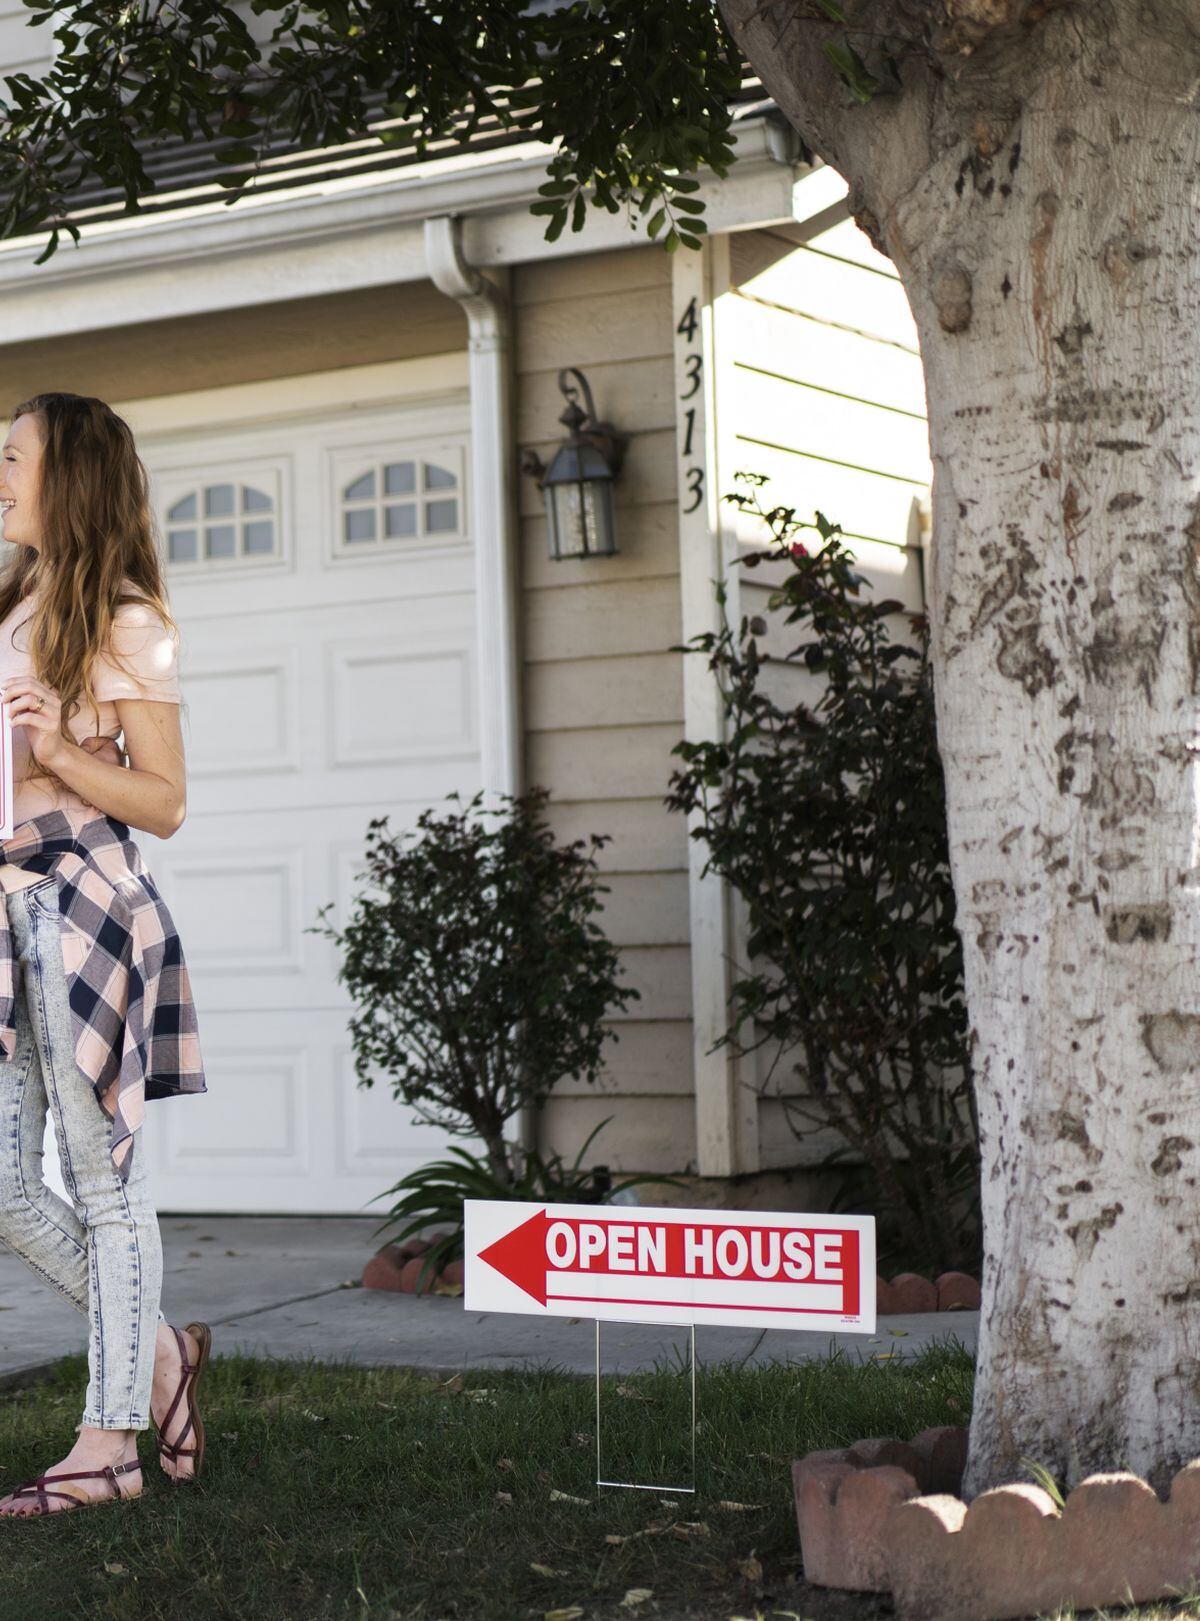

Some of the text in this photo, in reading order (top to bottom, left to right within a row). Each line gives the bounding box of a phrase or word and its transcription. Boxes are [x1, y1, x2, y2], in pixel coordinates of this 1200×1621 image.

[677, 296, 704, 514] 4313
[545, 1221, 843, 1281] OPEN HOUSE
